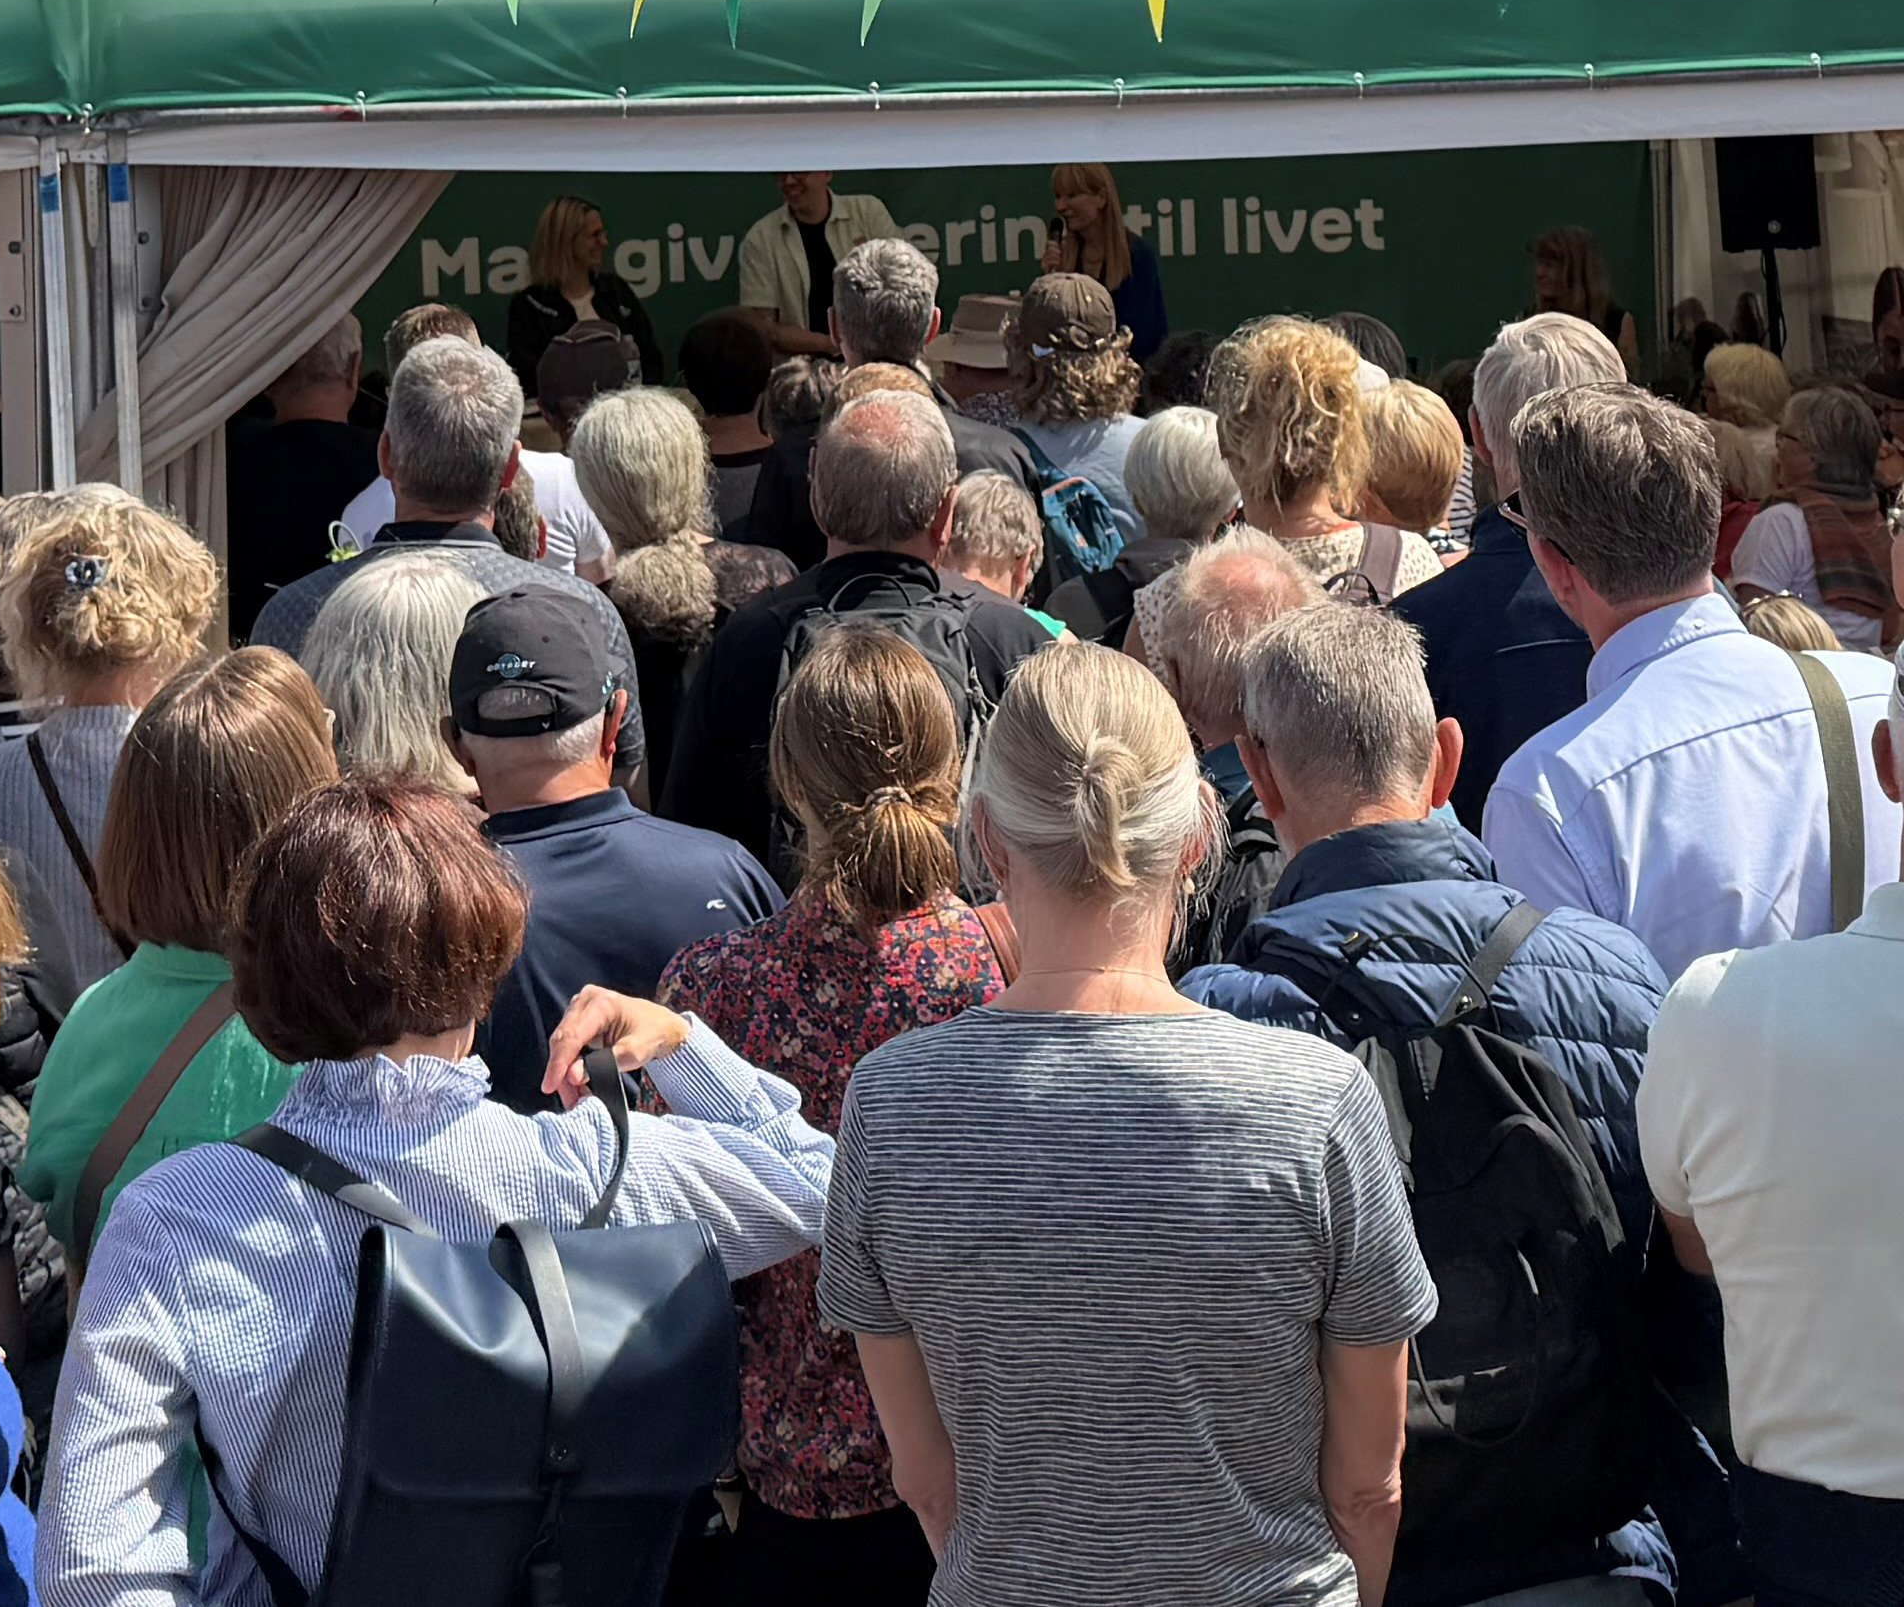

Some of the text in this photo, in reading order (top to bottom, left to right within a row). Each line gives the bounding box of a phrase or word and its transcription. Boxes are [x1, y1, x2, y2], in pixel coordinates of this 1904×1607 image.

[420, 236, 532, 298] Ma
[613, 222, 743, 300] giv
[1123, 197, 1196, 257] til
[1221, 195, 1386, 256] livet
